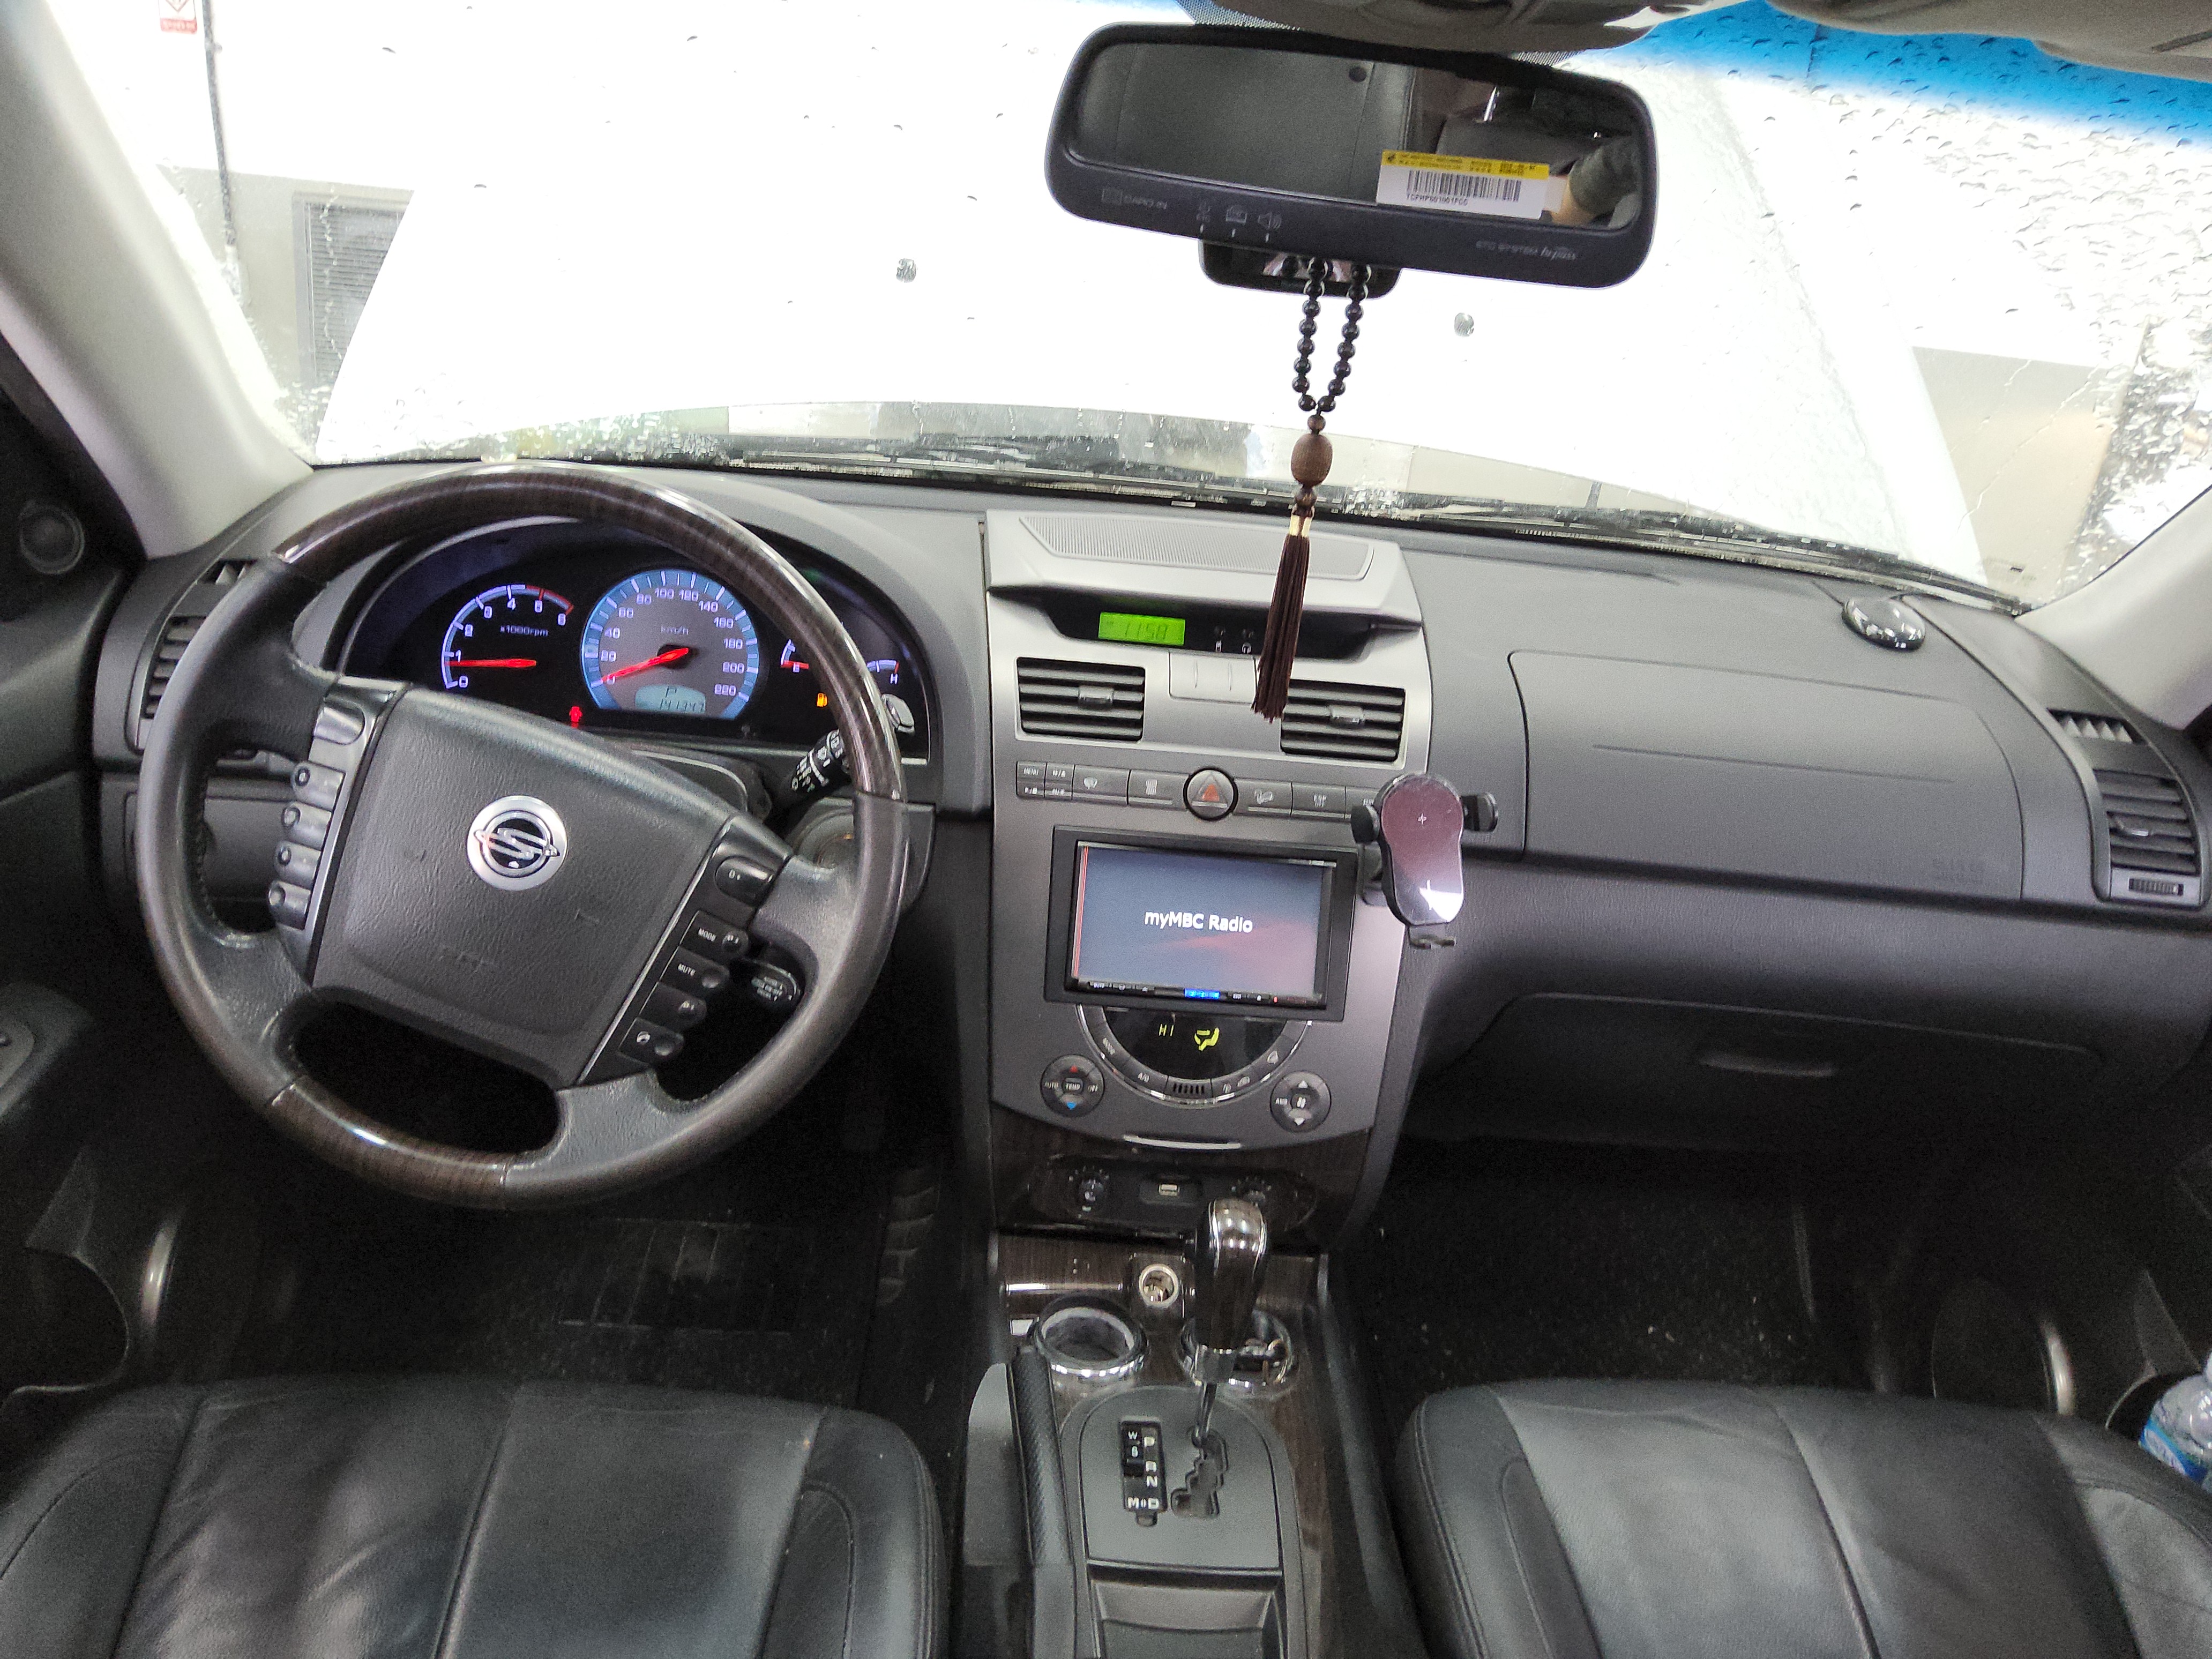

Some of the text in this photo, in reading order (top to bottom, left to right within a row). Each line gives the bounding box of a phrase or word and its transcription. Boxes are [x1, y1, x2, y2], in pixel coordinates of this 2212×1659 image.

[507, 597, 516, 610] 4
[459, 675, 468, 688] 0
[1145, 911, 1253, 933] myMBC Radio
[698, 927, 717, 943] MODE
[677, 963, 697, 977] MUTE
[1128, 1431, 1138, 1440] W
[1146, 1475, 1158, 1488] N
[1127, 1497, 1140, 1509] M
